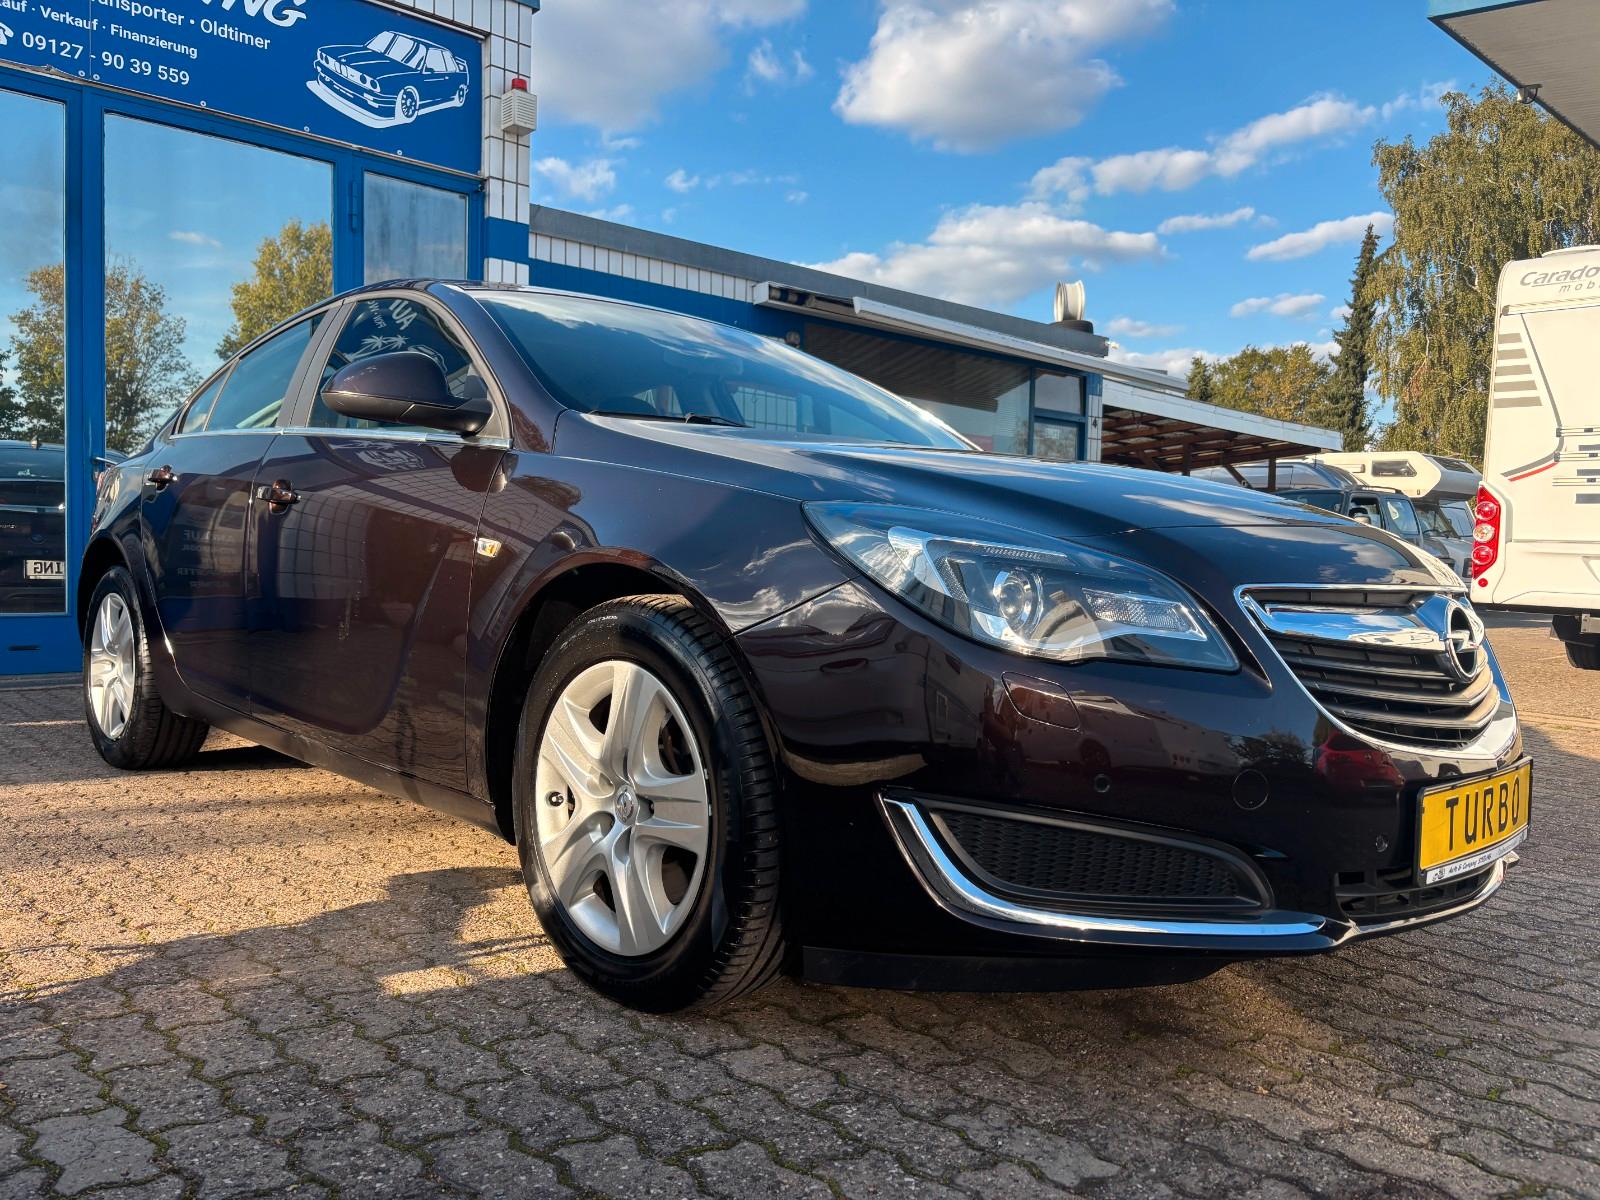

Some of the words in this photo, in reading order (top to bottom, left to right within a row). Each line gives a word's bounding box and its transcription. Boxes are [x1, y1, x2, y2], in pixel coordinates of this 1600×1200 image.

[0, 0, 28, 13] auf
[40, 5, 98, 31] Verkauf
[110, 24, 198, 59] Finanzierung
[91, 0, 185, 26] nsporter
[200, 19, 271, 50] Oldtimer
[202, 0, 307, 27] NG
[22, 32, 83, 59] 09127
[101, 51, 124, 69] 90
[130, 58, 151, 75] 39
[157, 65, 190, 85] 559
[1520, 265, 1600, 286] Carado
[1559, 280, 1600, 293] mob
[1446, 776, 1520, 851] TURBO
